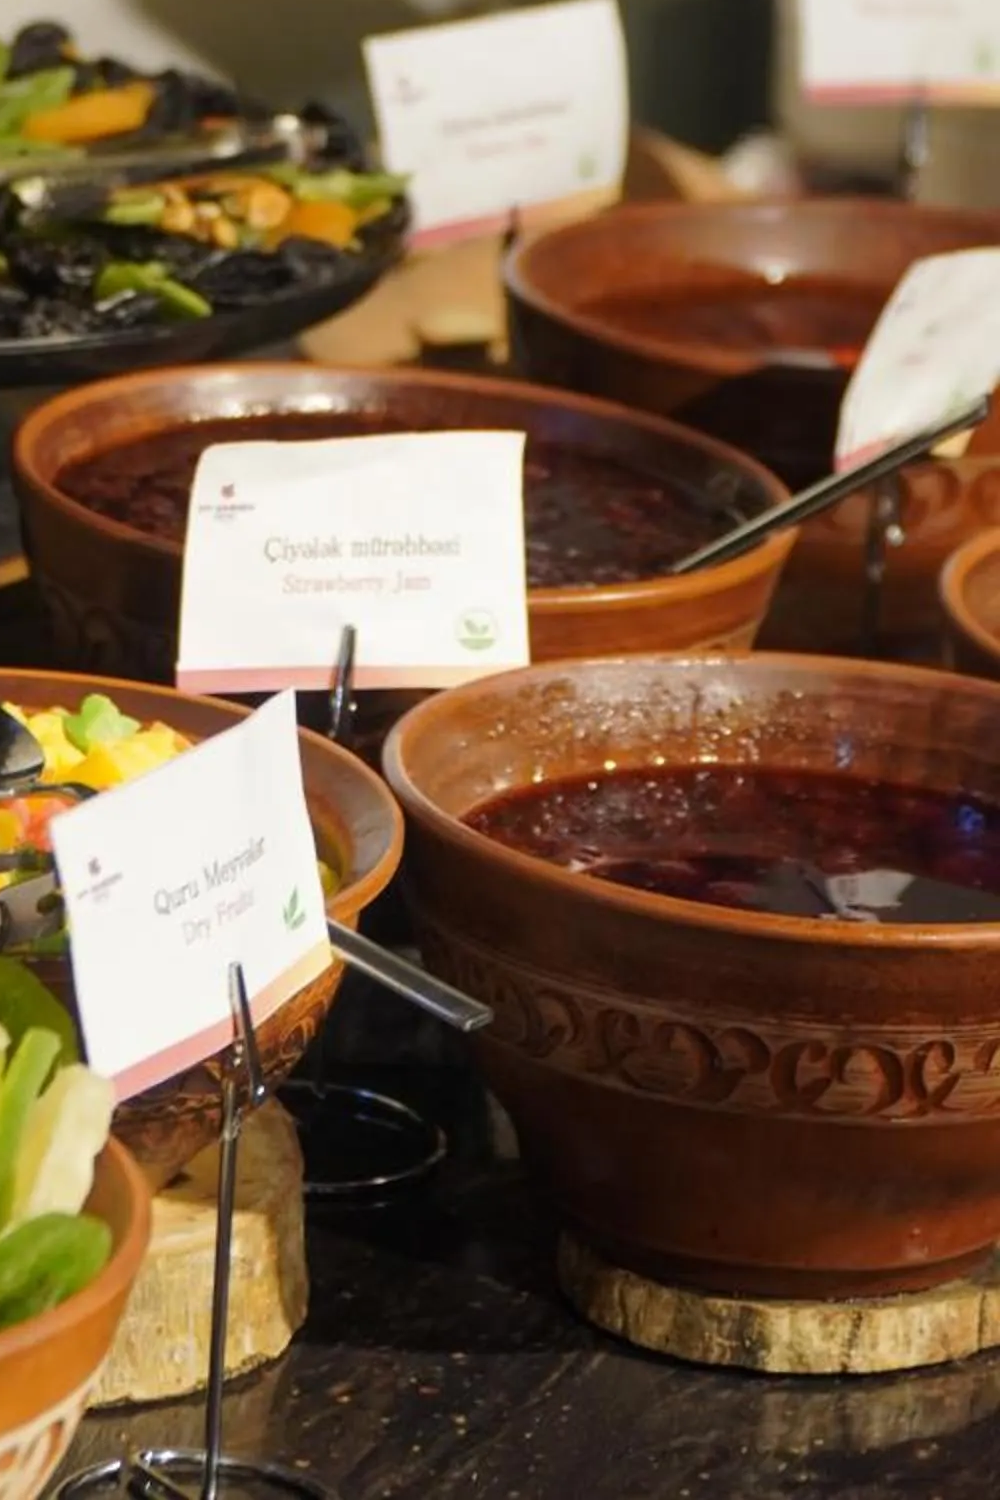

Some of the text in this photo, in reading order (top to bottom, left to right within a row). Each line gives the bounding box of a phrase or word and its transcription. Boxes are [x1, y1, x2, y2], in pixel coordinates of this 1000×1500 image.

[282, 569, 432, 595] Strawberry Jam
[153, 880, 200, 916] Quru
[181, 917, 212, 946] Dry
